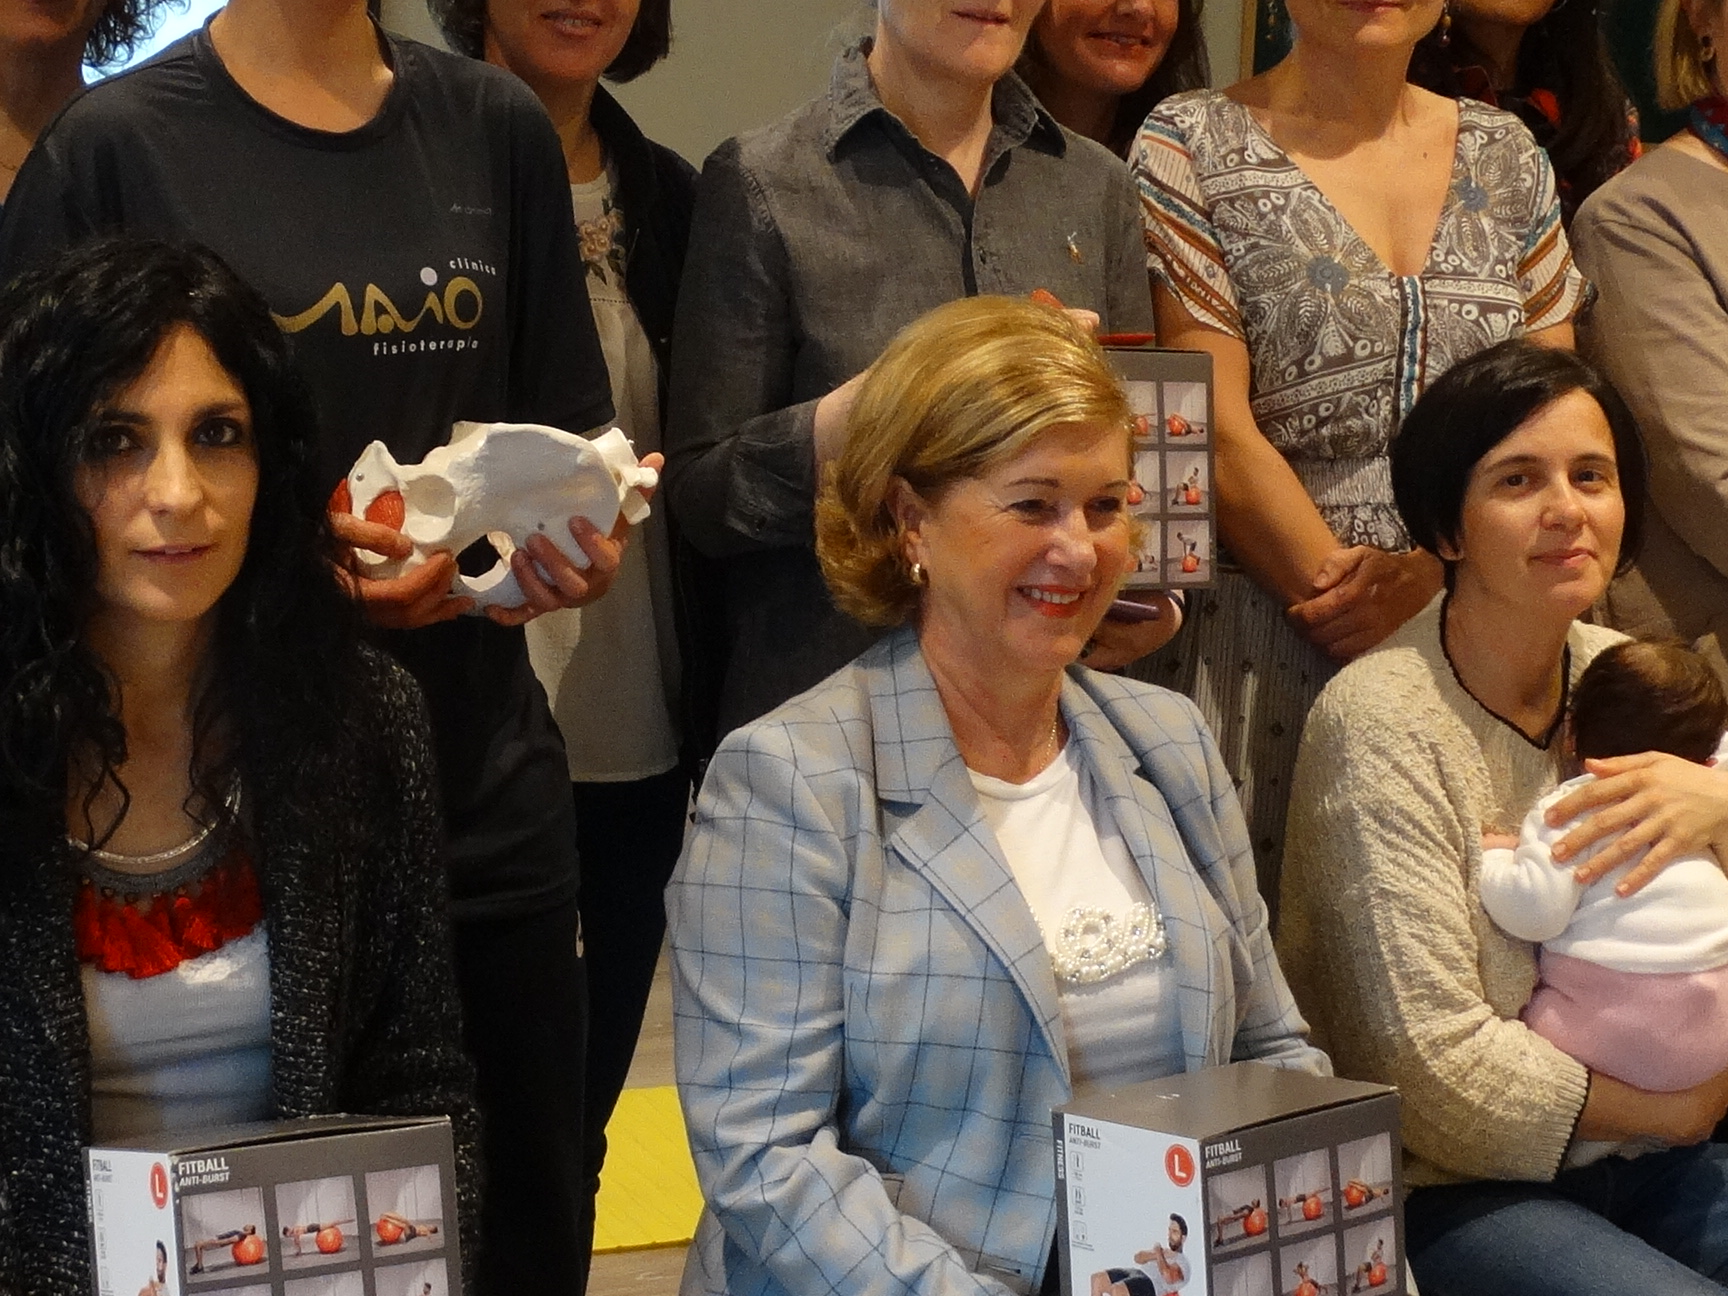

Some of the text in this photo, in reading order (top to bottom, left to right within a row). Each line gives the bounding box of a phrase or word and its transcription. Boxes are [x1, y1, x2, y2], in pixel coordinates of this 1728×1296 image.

[373, 338, 479, 355] fisioterapia
[1068, 1122, 1101, 1140] FITBALL
[1056, 1139, 1065, 1180] FITNESS
[1205, 1139, 1242, 1160] FITBALL
[178, 1156, 229, 1176] FITBALL
[1174, 1153, 1187, 1178] L
[155, 1173, 164, 1198] L
[178, 1171, 231, 1187] ANTI-BURST
